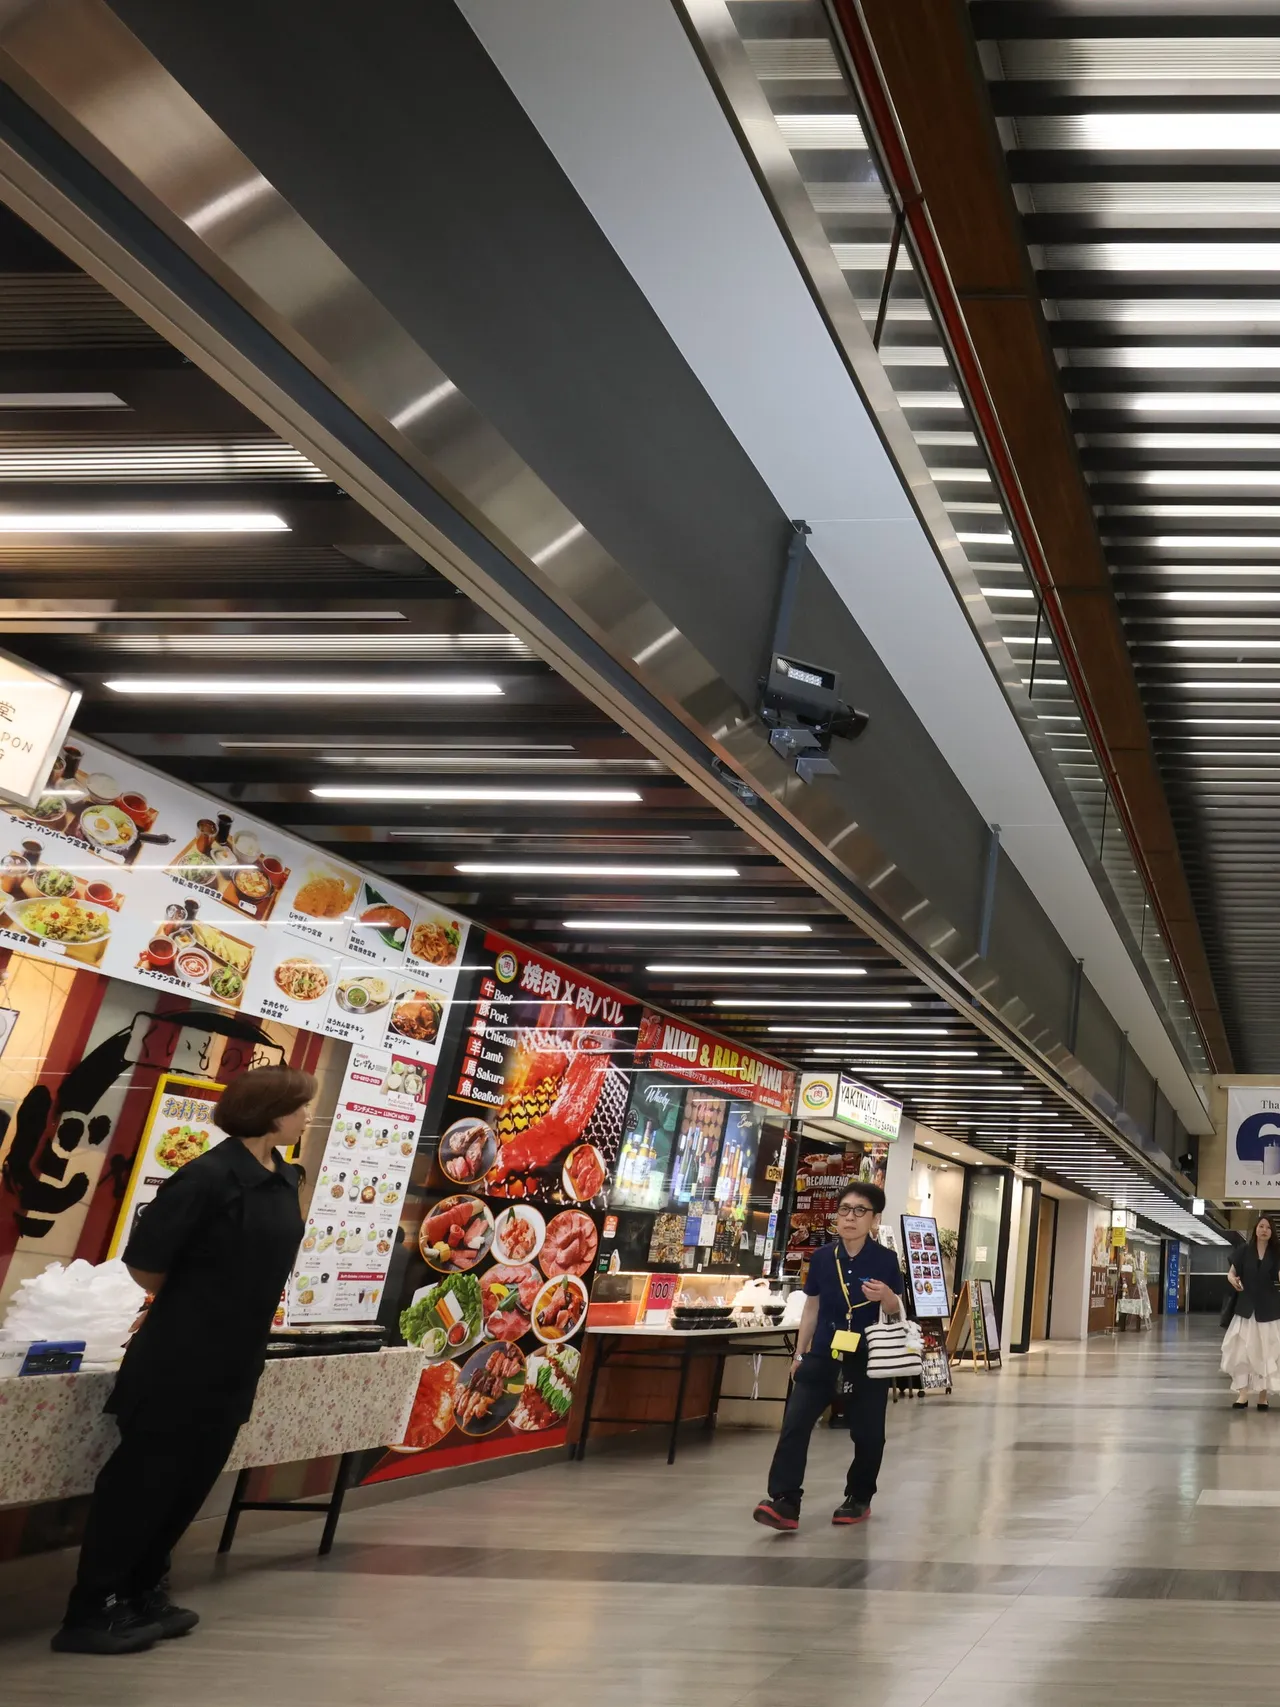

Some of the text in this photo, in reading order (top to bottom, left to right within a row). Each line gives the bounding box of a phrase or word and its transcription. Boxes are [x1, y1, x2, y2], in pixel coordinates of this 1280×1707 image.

[483, 981, 514, 1005] 牛 Beef
[489, 1009, 510, 1025] Pork
[485, 1026, 517, 1049] Chicken
[470, 1040, 504, 1064] 羊 Lamb
[662, 1025, 783, 1093] NIKU & BAR SAPANA
[464, 1060, 505, 1085] 馬 Sakura
[460, 1079, 504, 1104] 魚 Seafood
[841, 1085, 879, 1115] YAKINIKU
[162, 1096, 216, 1125] お持ち
[881, 1120, 897, 1134] SAPANA
[768, 1168, 782, 1180] OPEN
[806, 1175, 849, 1187] RECOMMEND
